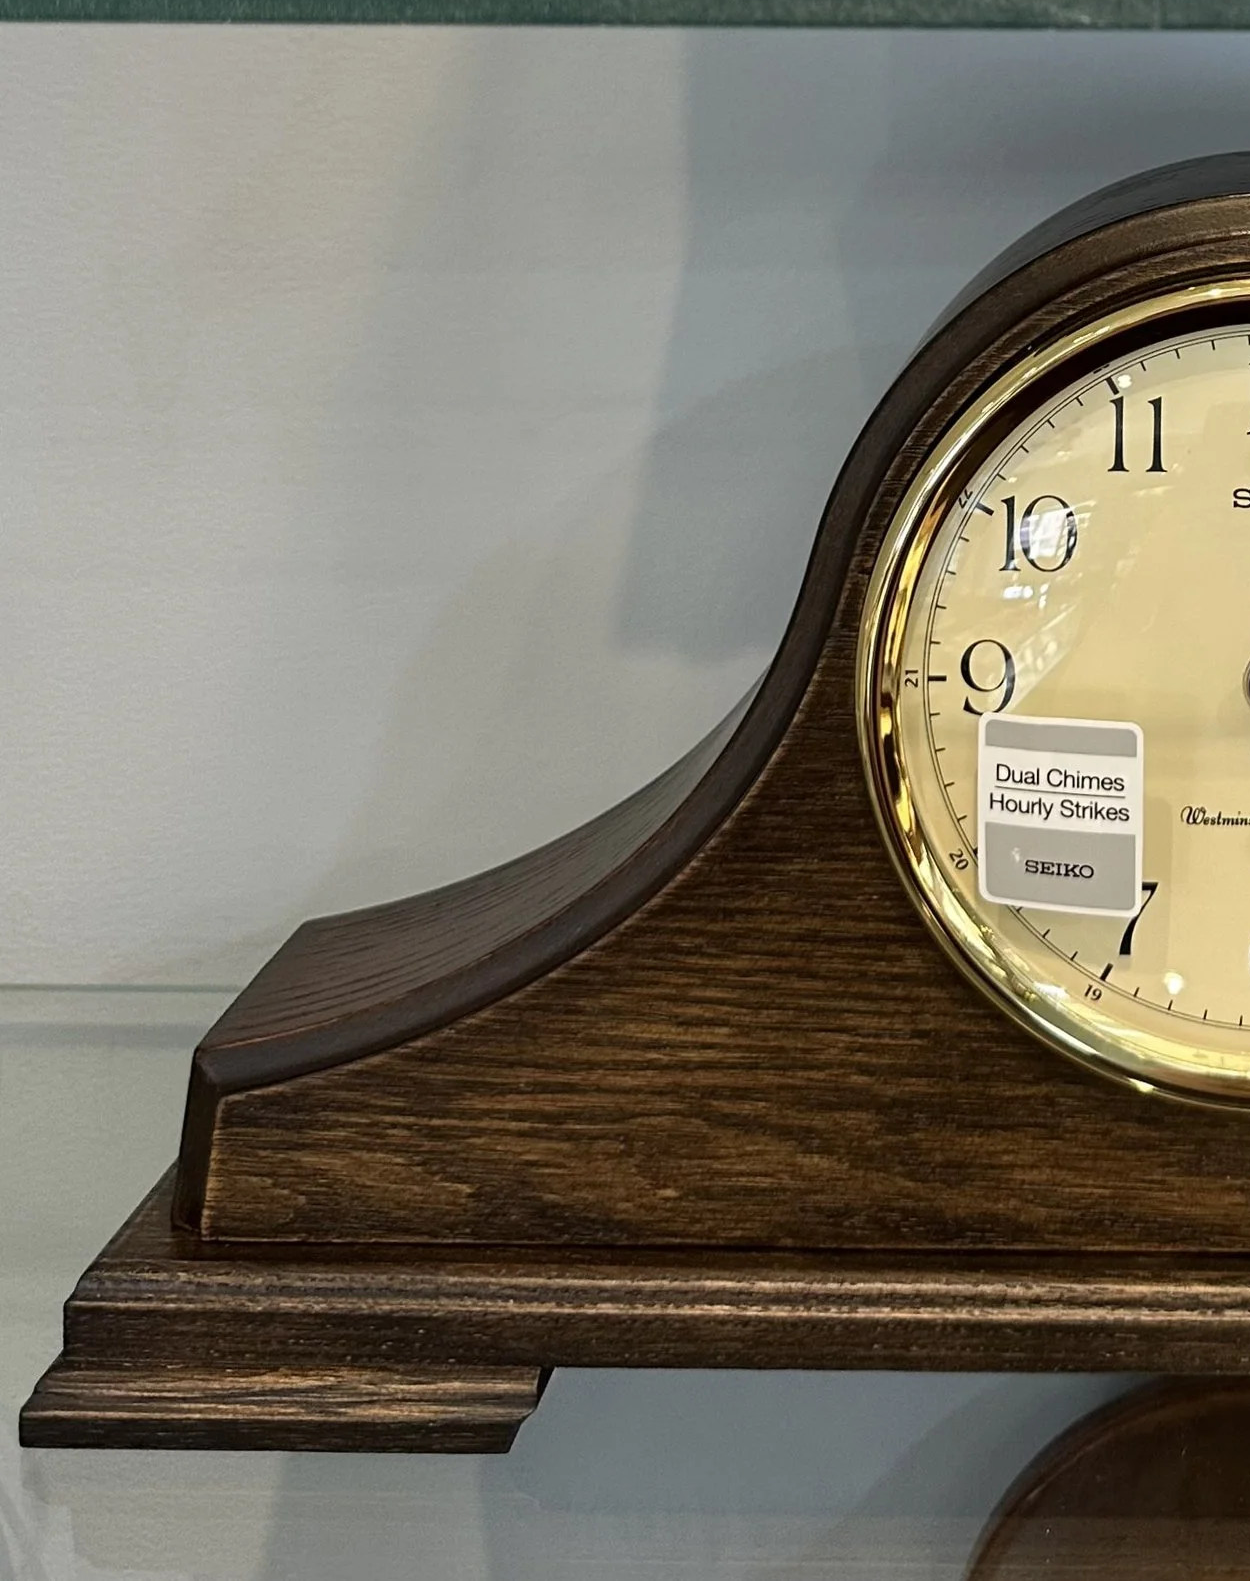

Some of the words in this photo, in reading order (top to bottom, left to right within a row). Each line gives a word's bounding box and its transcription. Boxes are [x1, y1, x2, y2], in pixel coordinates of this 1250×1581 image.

[1107, 396, 1168, 473] 11
[999, 495, 1078, 572] 10
[905, 668, 919, 687] 21
[960, 639, 1016, 716] 9
[996, 763, 1041, 786] Dual
[1046, 767, 1125, 792] Chimes
[989, 793, 1054, 820] Hourly
[1060, 799, 1130, 822] Strikes
[949, 850, 969, 871] 20
[1024, 859, 1095, 879] SEIKO
[1083, 983, 1103, 1002] 19
